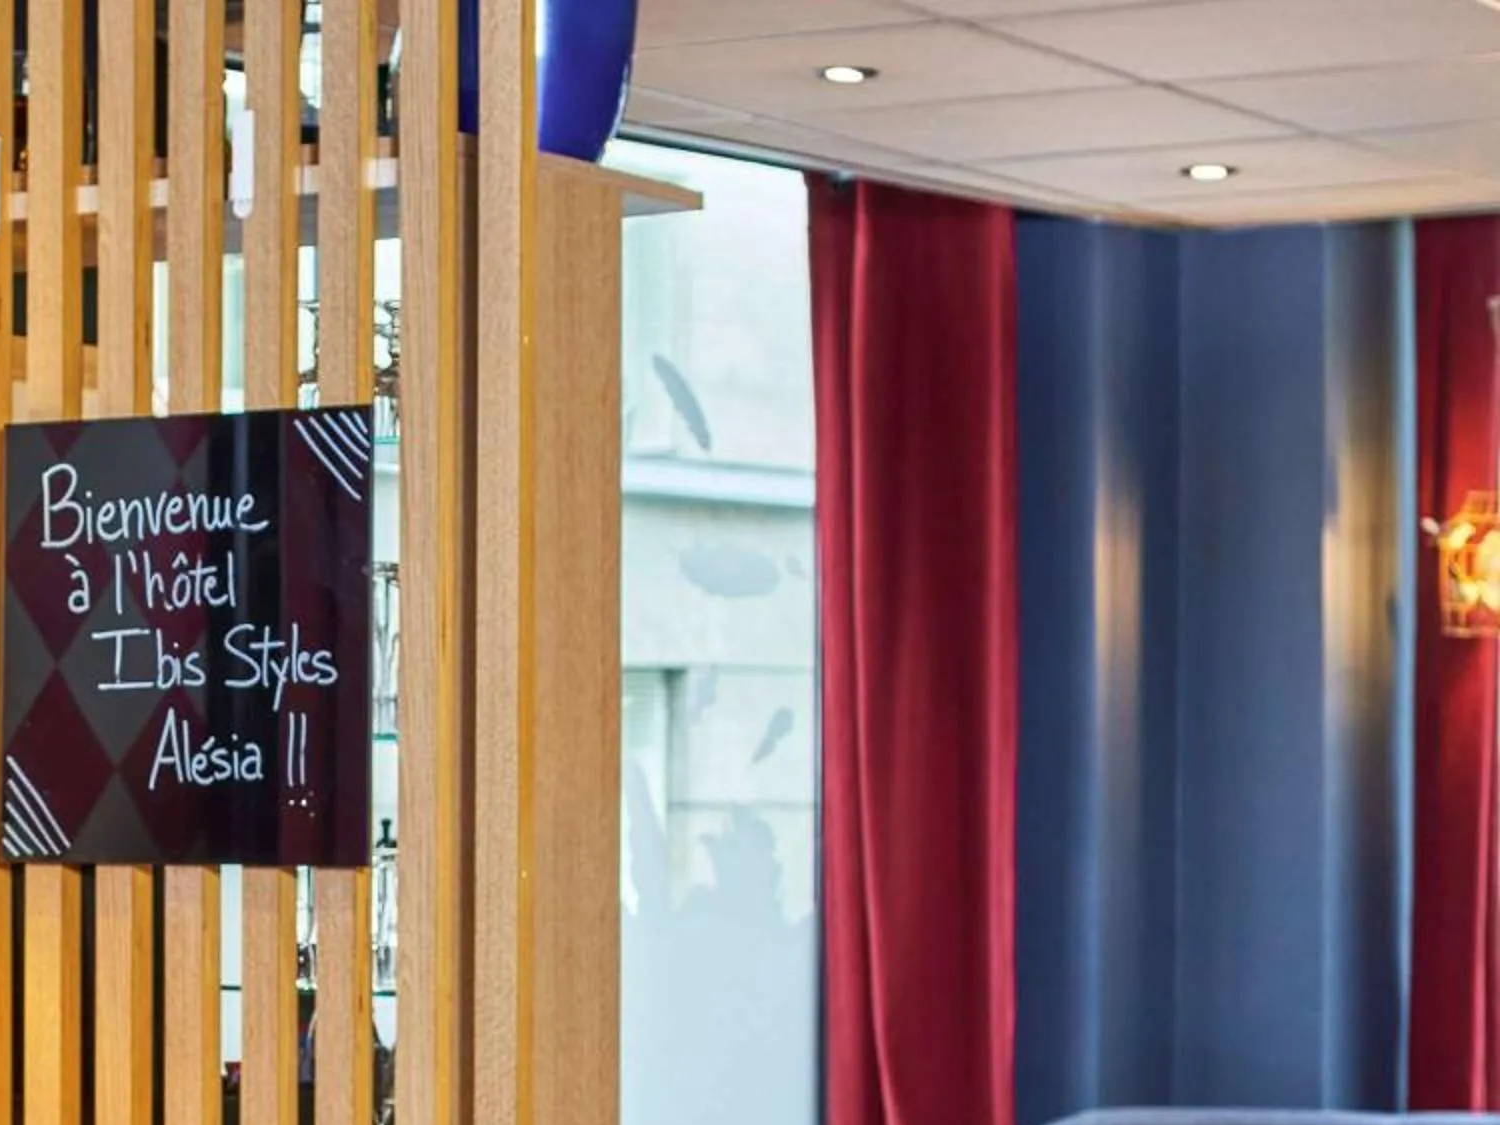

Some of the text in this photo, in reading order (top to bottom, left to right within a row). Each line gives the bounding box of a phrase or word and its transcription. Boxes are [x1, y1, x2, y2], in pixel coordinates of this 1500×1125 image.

[41, 463, 269, 548] Bienvenue
[64, 550, 237, 615] à l'hôtel
[91, 623, 339, 711] Ibis Styles
[148, 707, 264, 790] Alésia
